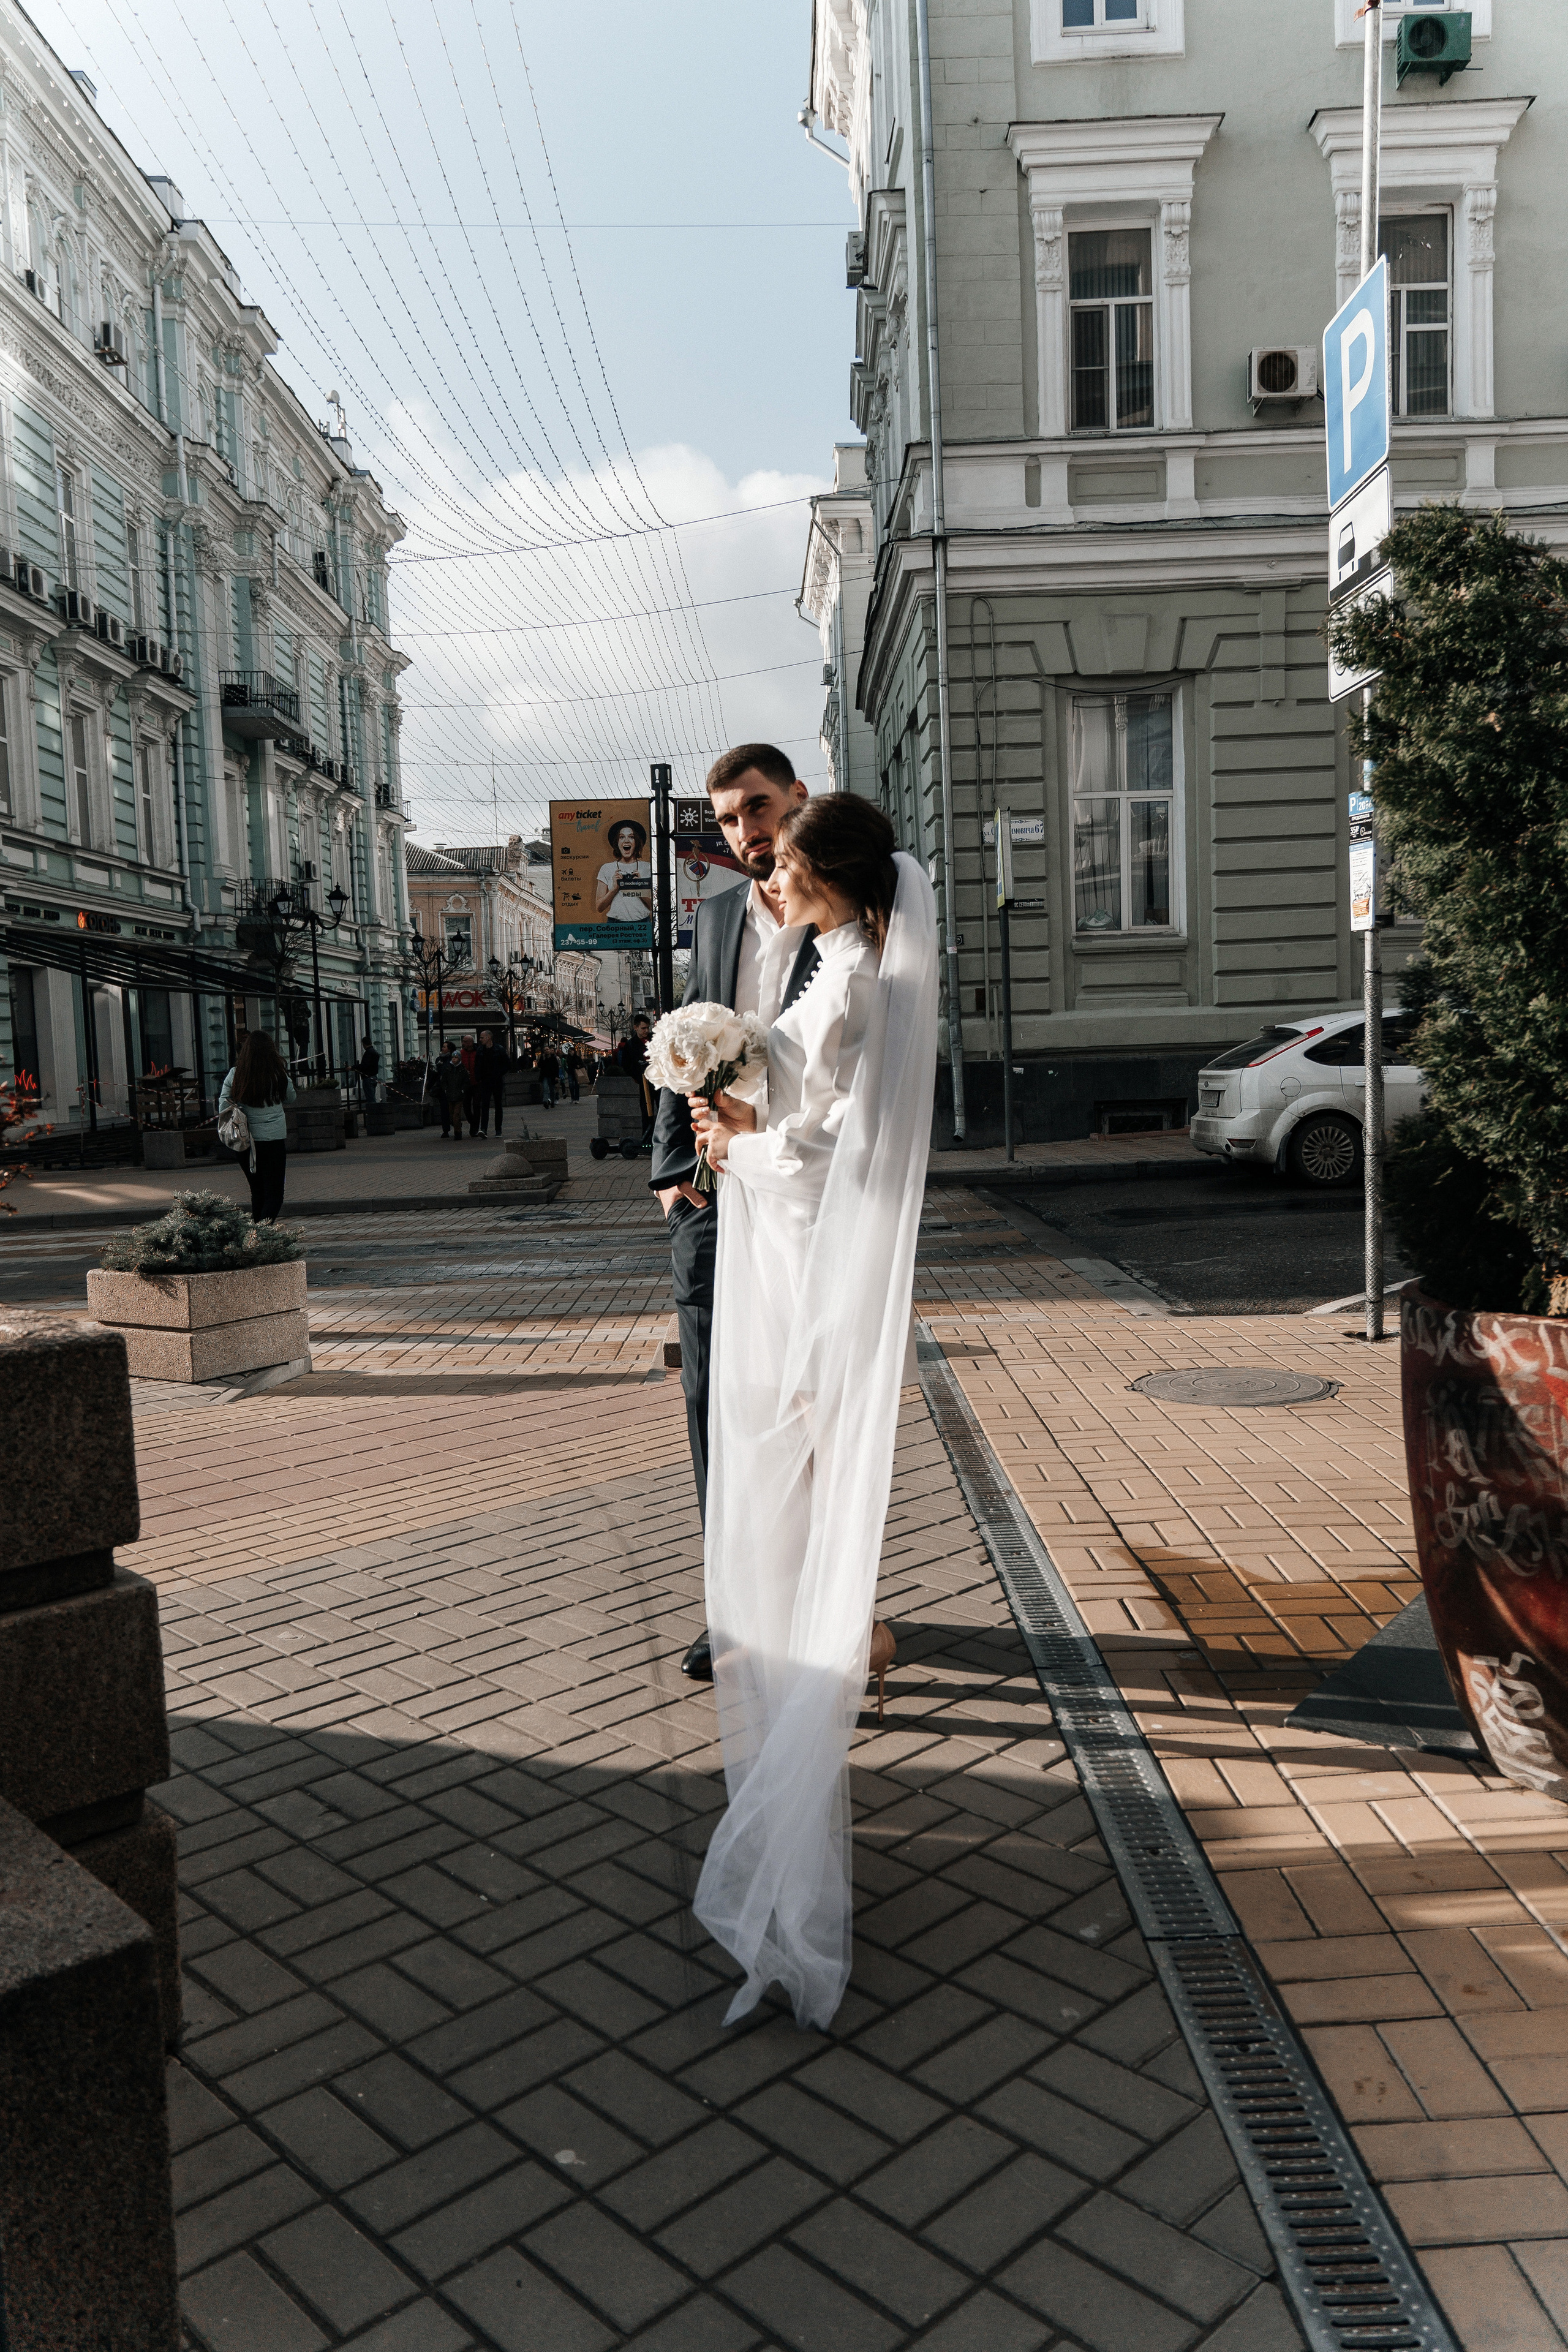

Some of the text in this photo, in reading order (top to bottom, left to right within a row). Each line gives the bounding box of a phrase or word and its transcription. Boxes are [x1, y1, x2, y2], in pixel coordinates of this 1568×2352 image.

[1340, 308, 1375, 475] P
[1349, 797, 1356, 812] P
[1035, 823, 1044, 834] 67
[442, 990, 488, 1008] WOK
